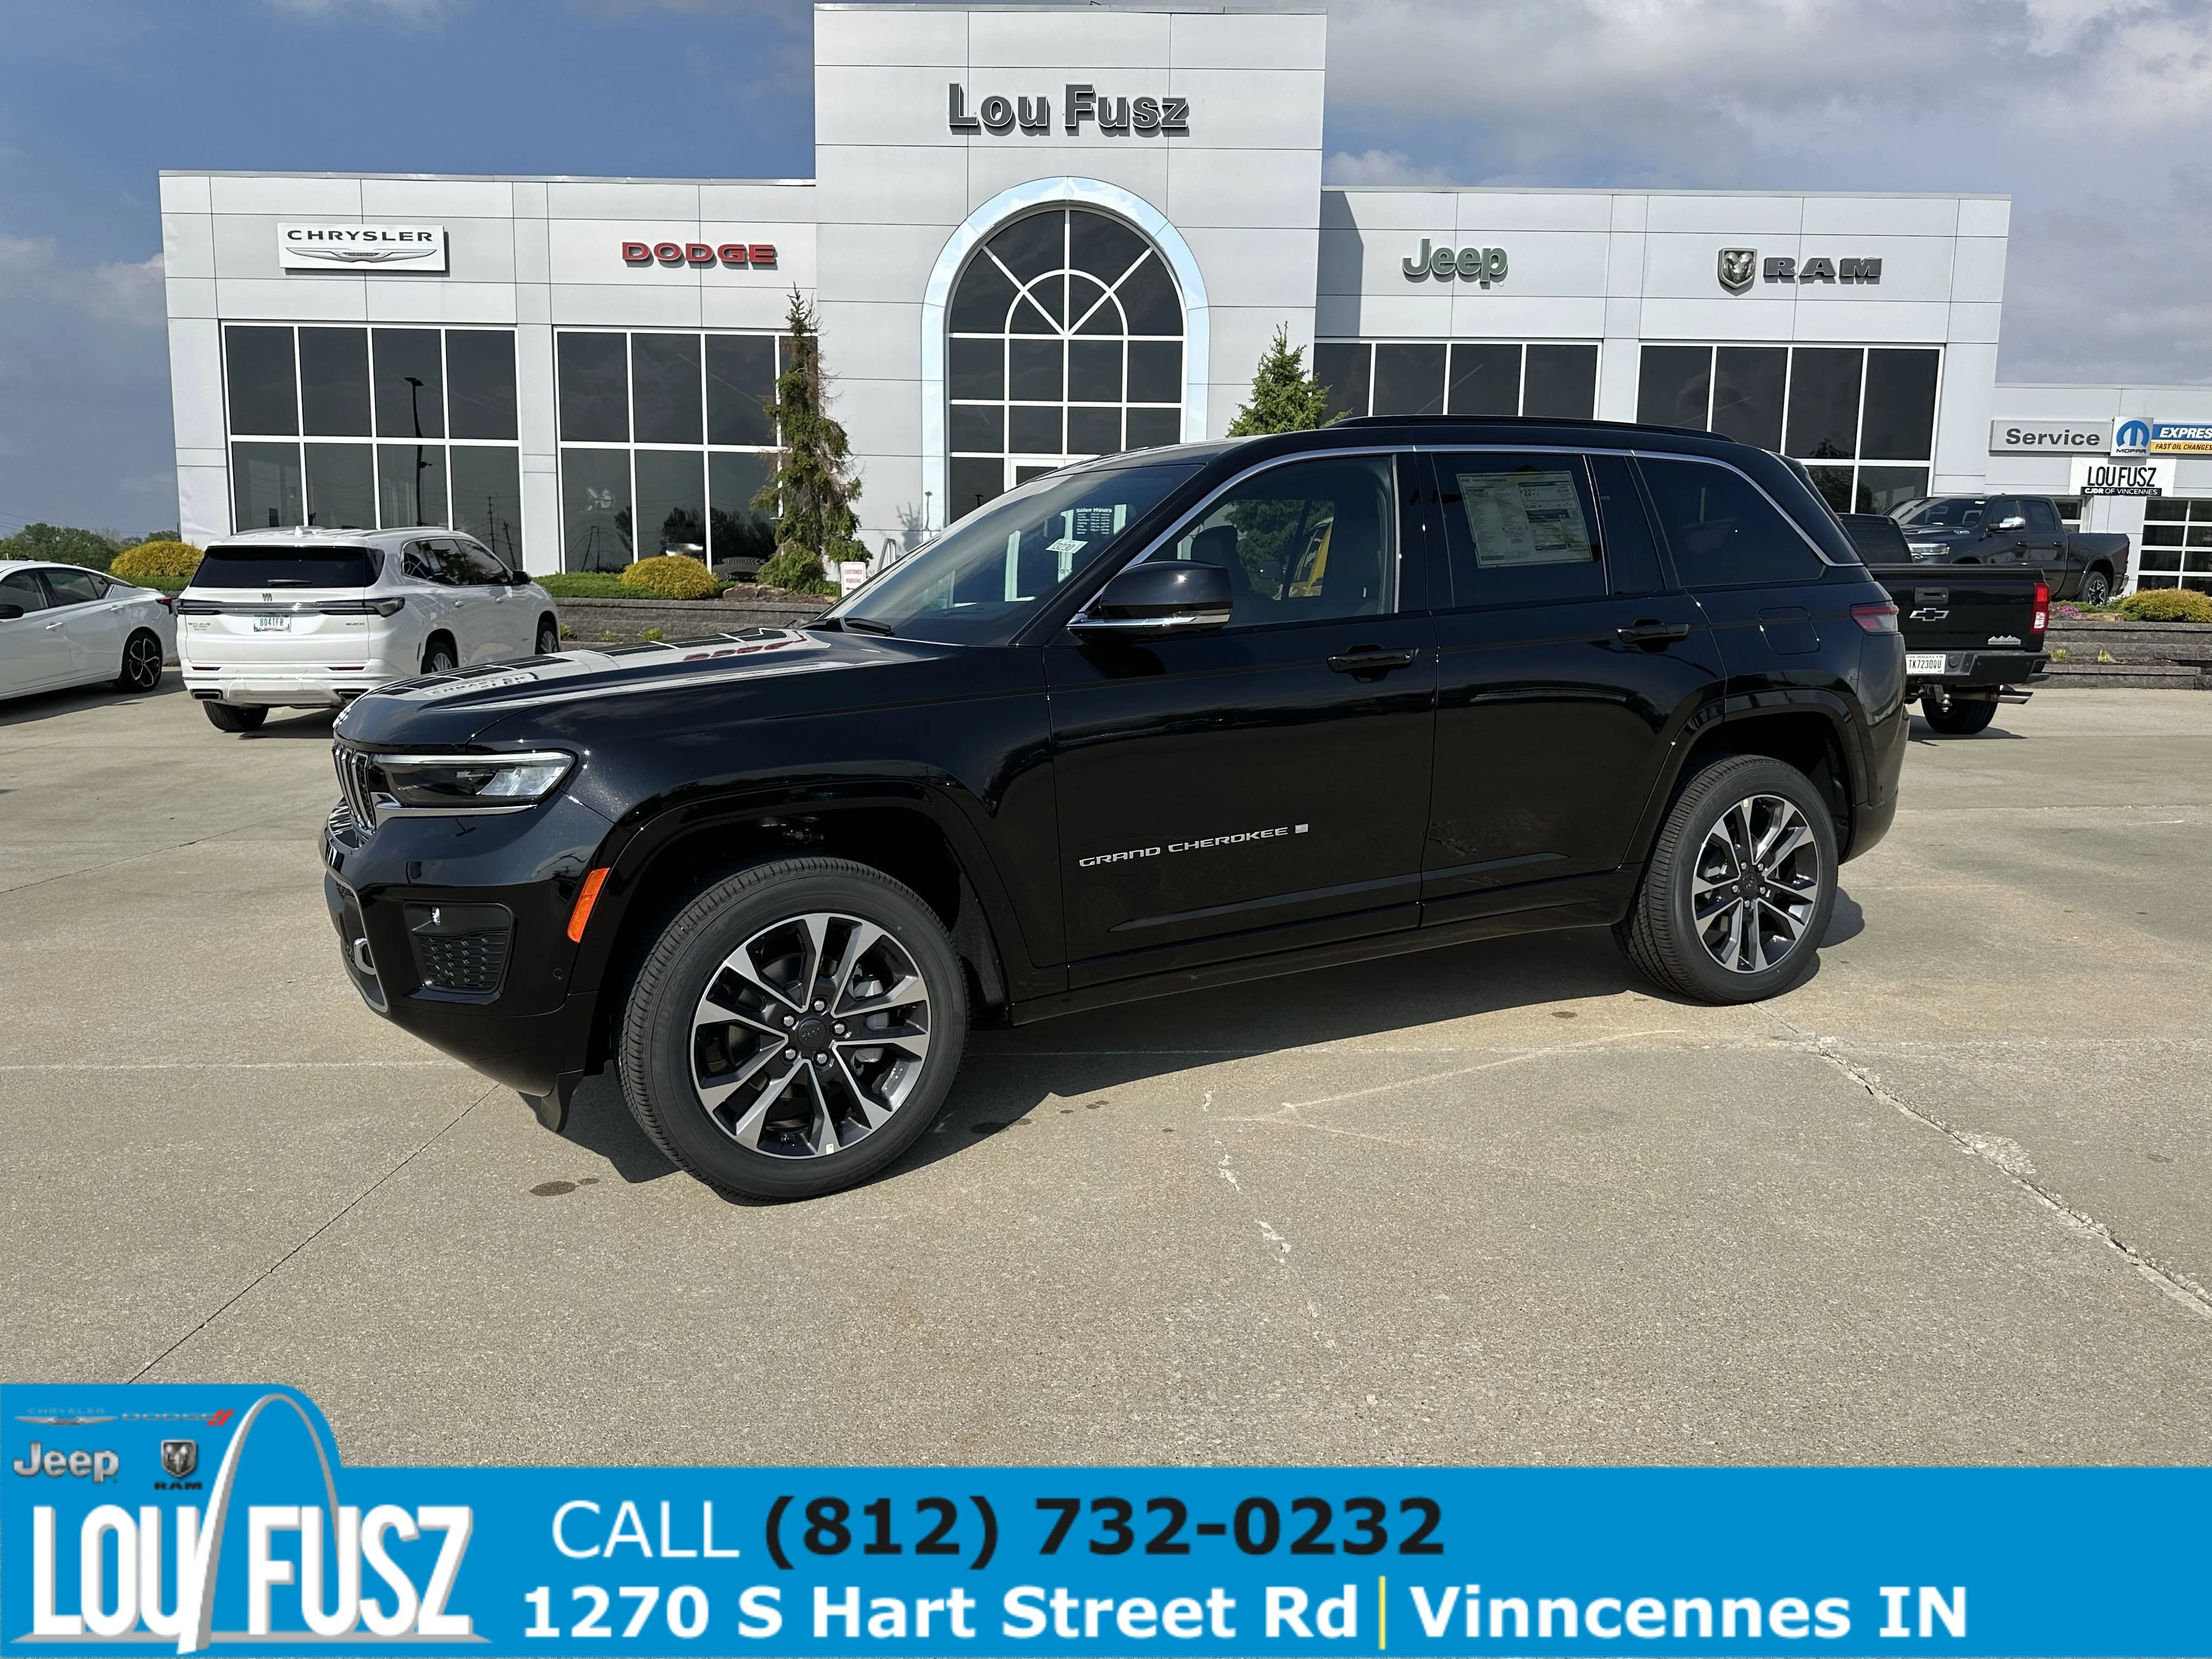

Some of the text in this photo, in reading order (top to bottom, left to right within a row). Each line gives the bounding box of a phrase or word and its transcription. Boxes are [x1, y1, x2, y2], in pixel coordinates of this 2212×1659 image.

[949, 82, 1188, 128] Lou Fusz
[287, 230, 433, 241] CHRYSLER
[622, 242, 774, 262] DODGE
[1402, 238, 1508, 283] Jeep
[1763, 257, 1882, 276] RAM
[2005, 428, 2100, 445] Service
[2087, 466, 2157, 487] LOU FUSZ
[259, 618, 284, 627] 804TFR
[1079, 827, 1288, 867] GRAND CHEROKEE
